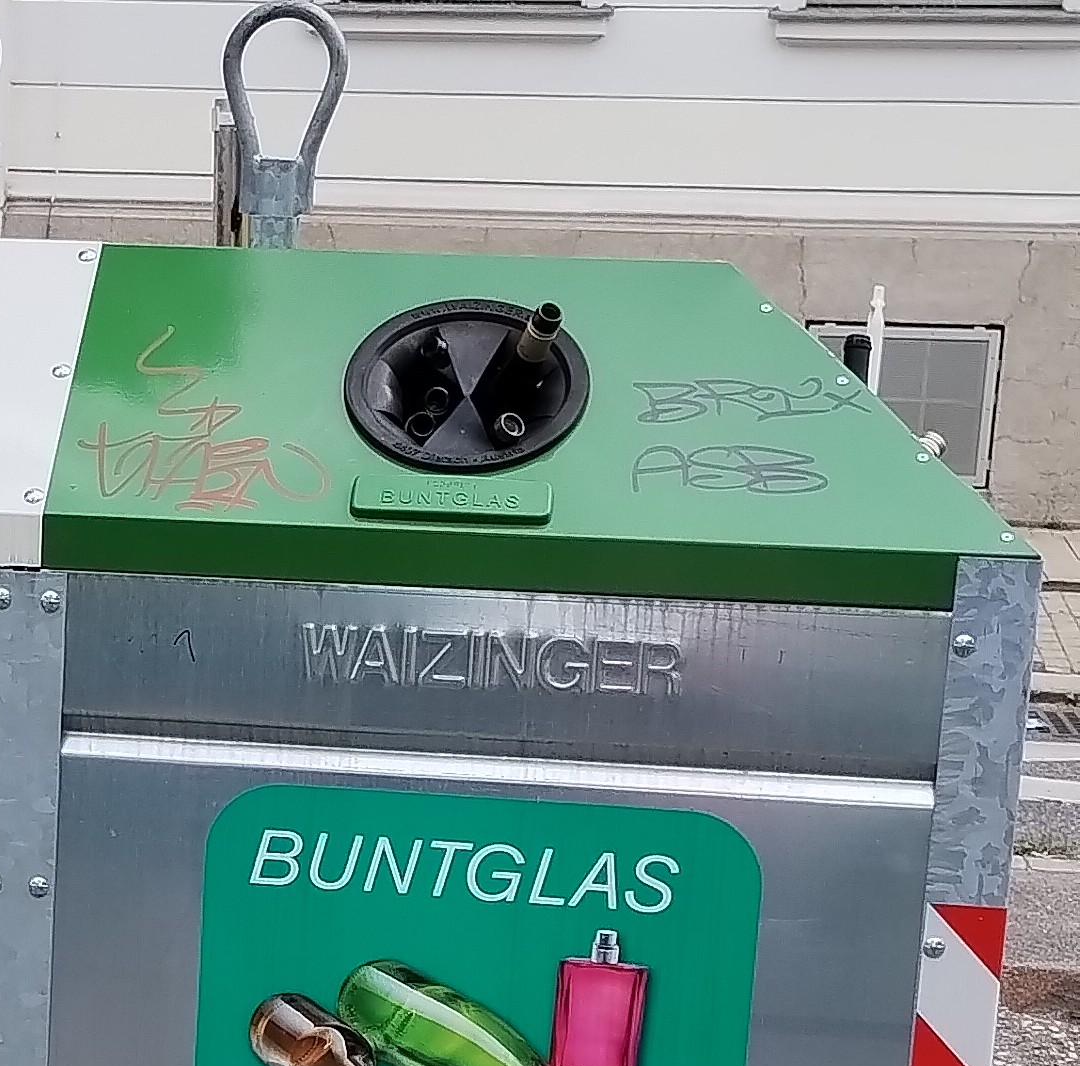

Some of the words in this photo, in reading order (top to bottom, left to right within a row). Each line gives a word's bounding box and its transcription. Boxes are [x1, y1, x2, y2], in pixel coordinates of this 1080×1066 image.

[380, 489, 520, 509] BUNTGLAS
[302, 622, 682, 695] WAIZINGER
[249, 828, 681, 914] BUNTGLAS
